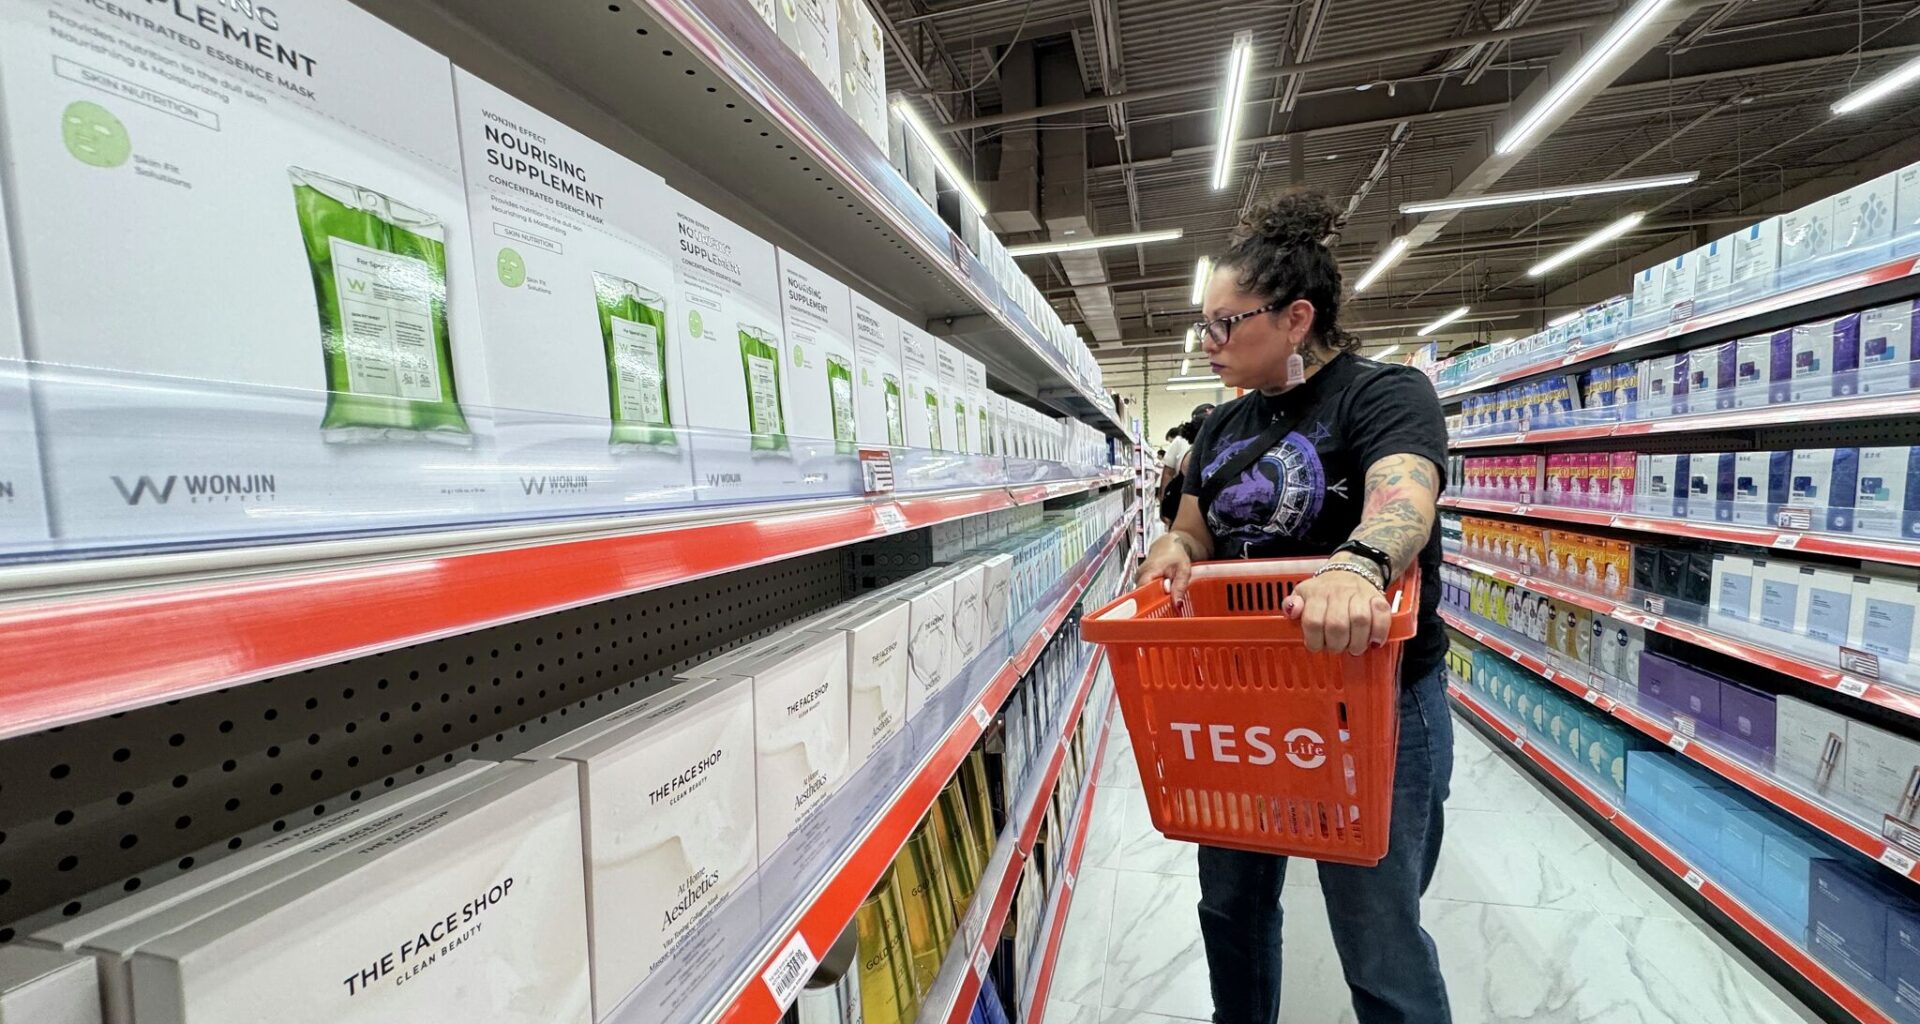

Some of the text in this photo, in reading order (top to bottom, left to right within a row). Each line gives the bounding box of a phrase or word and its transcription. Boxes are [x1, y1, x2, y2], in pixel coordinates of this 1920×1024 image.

[48, 8, 116, 44] Provides
[118, 35, 179, 68] nutrition
[180, 62, 196, 76] to
[197, 67, 218, 87] the
[220, 75, 243, 97] dull
[50, 25, 230, 104] Nourishing & Moisturizing
[206, 45, 274, 82] ESSENCE
[277, 76, 317, 102] MASK
[80, 69, 200, 120] SKIN NUTRITION
[481, 109, 546, 145] WONJIN EFFECT
[485, 124, 586, 183] NOURISING
[487, 148, 604, 209] SUPPLEMENT
[488, 174, 604, 225] CONCENTRATED ESSENCE MASK
[503, 228, 554, 248] SKIN NUTRITION
[184, 474, 275, 495] WONJIN
[191, 495, 275, 503] EFFECT
[549, 475, 588, 489] WONJIN
[787, 682, 828, 716] THE FACE SHOP
[1170, 722, 1327, 769] TESO
[1287, 742, 1324, 756] Life
[648, 750, 722, 805] THE FACE SHOP
[669, 776, 707, 806] CLEAN BEAUTY
[358, 810, 448, 855] THE FACE SHOP
[661, 869, 719, 932] Aesthetics
[678, 883, 686, 897] At
[343, 877, 513, 997] THE FACE SHOP
[396, 922, 482, 986] CLEAN BEAUTY
[865, 945, 890, 970] GOLD
